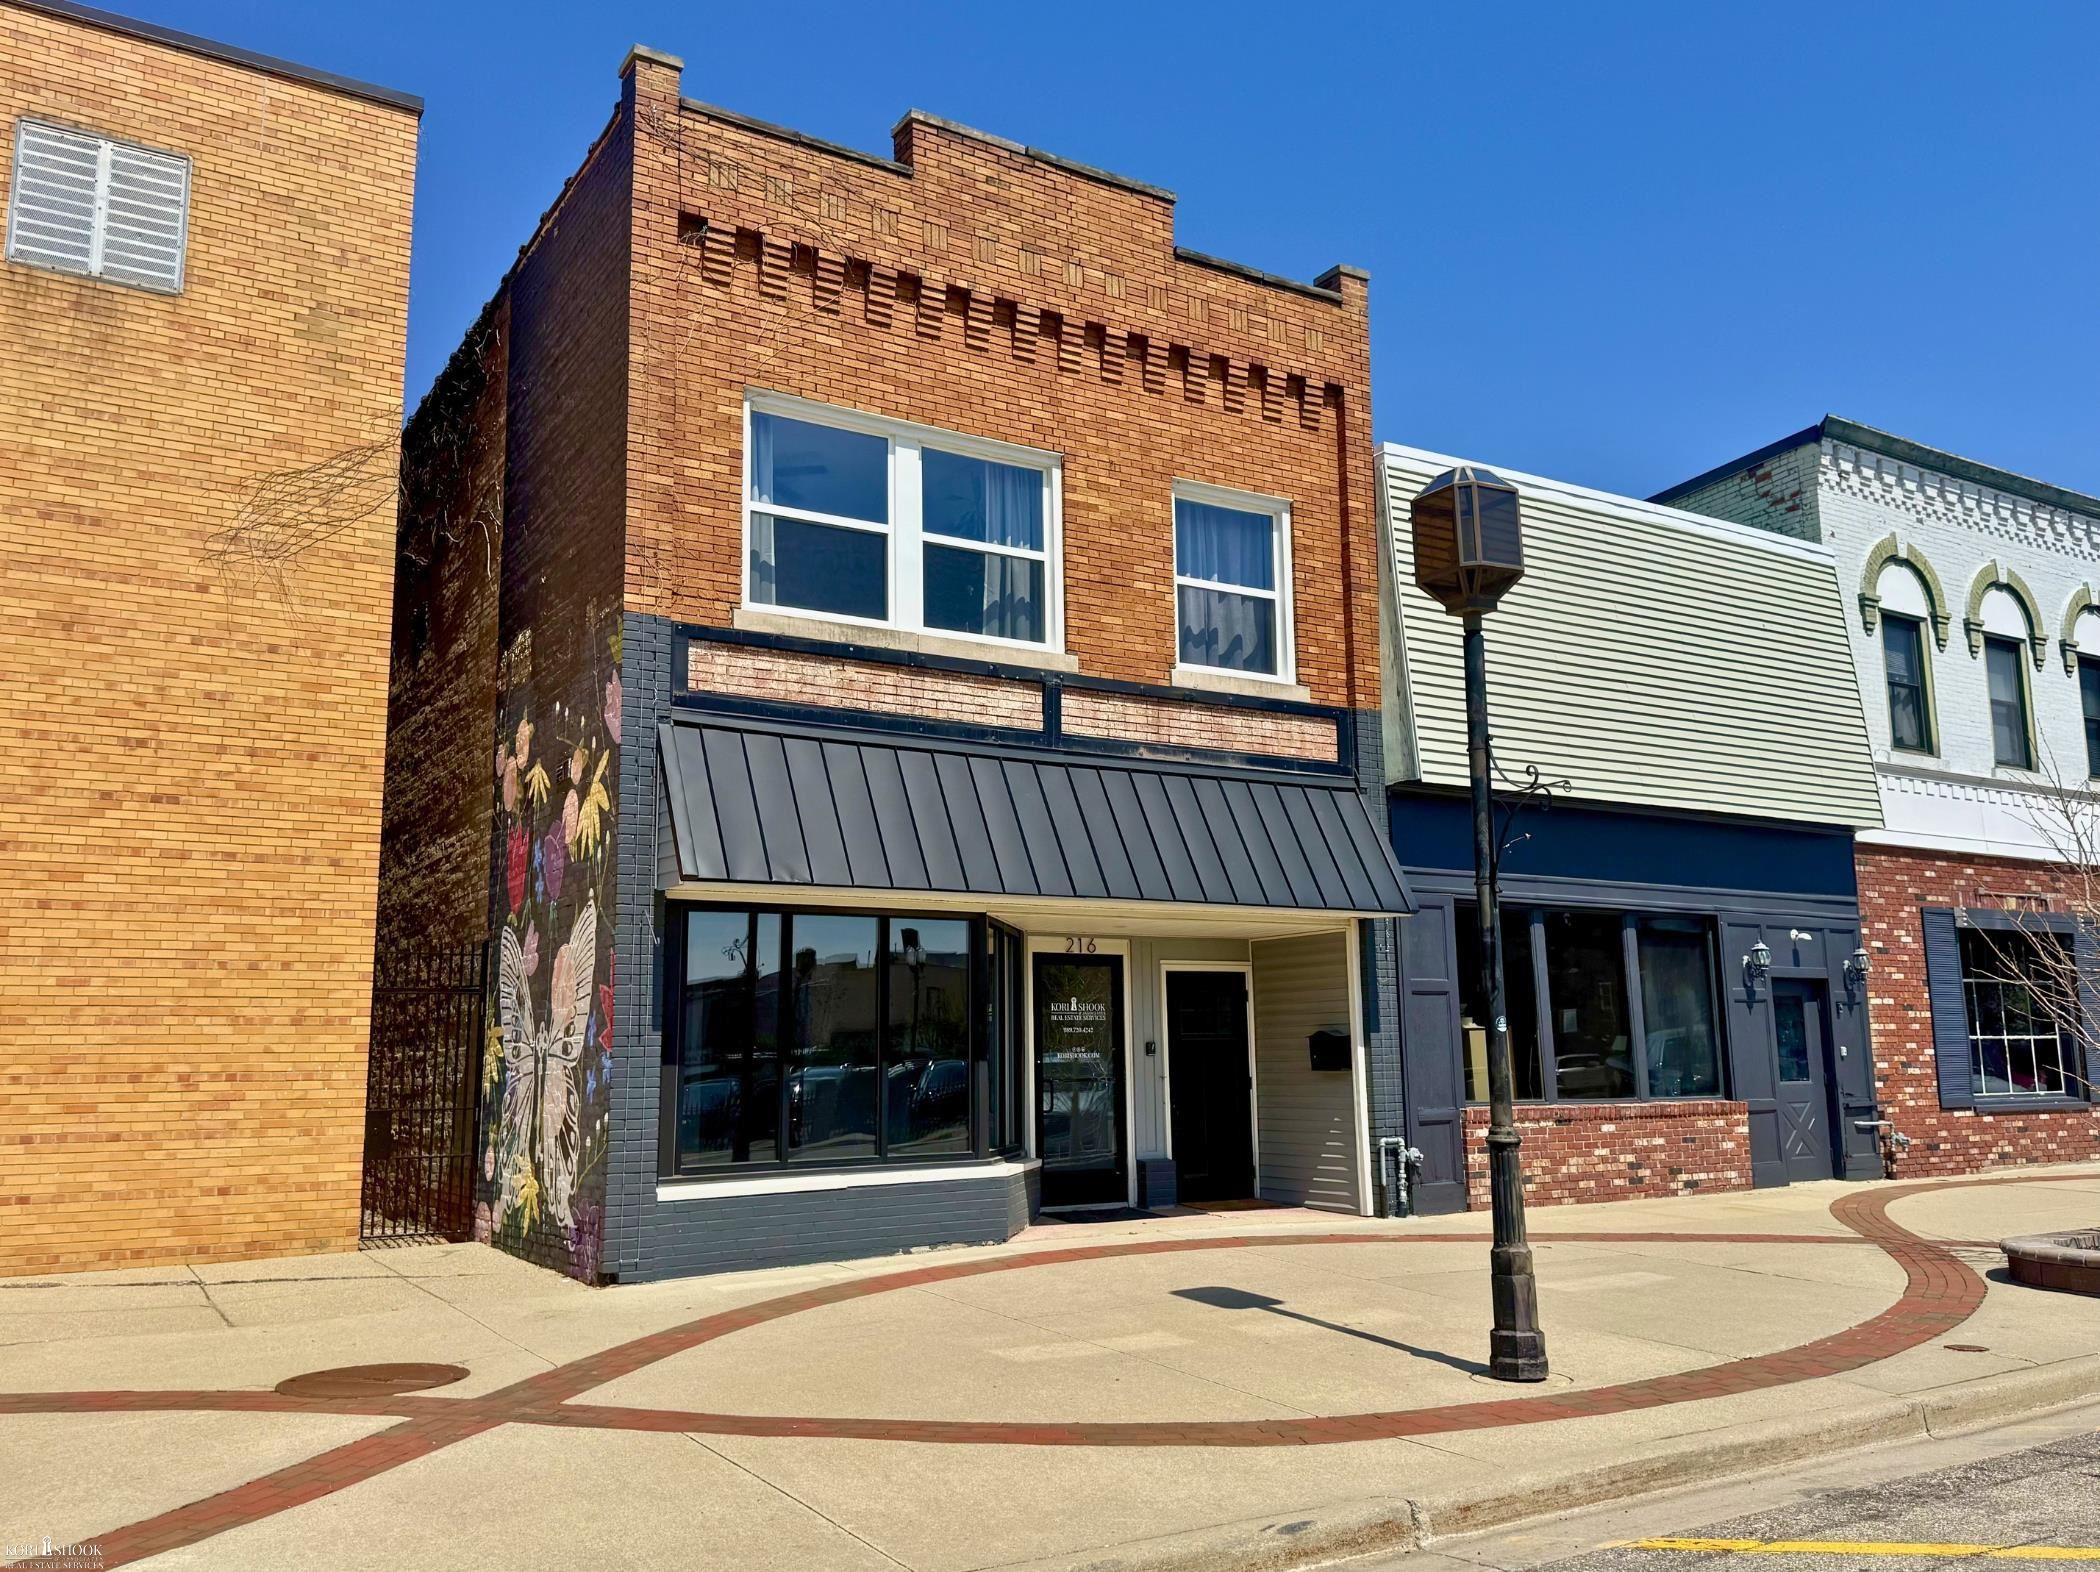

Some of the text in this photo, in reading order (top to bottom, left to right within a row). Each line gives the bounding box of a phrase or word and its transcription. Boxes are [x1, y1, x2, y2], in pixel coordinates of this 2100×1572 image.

[1066, 937, 1096, 953] 216
[1051, 1003, 1105, 1011] KORI SHOOK
